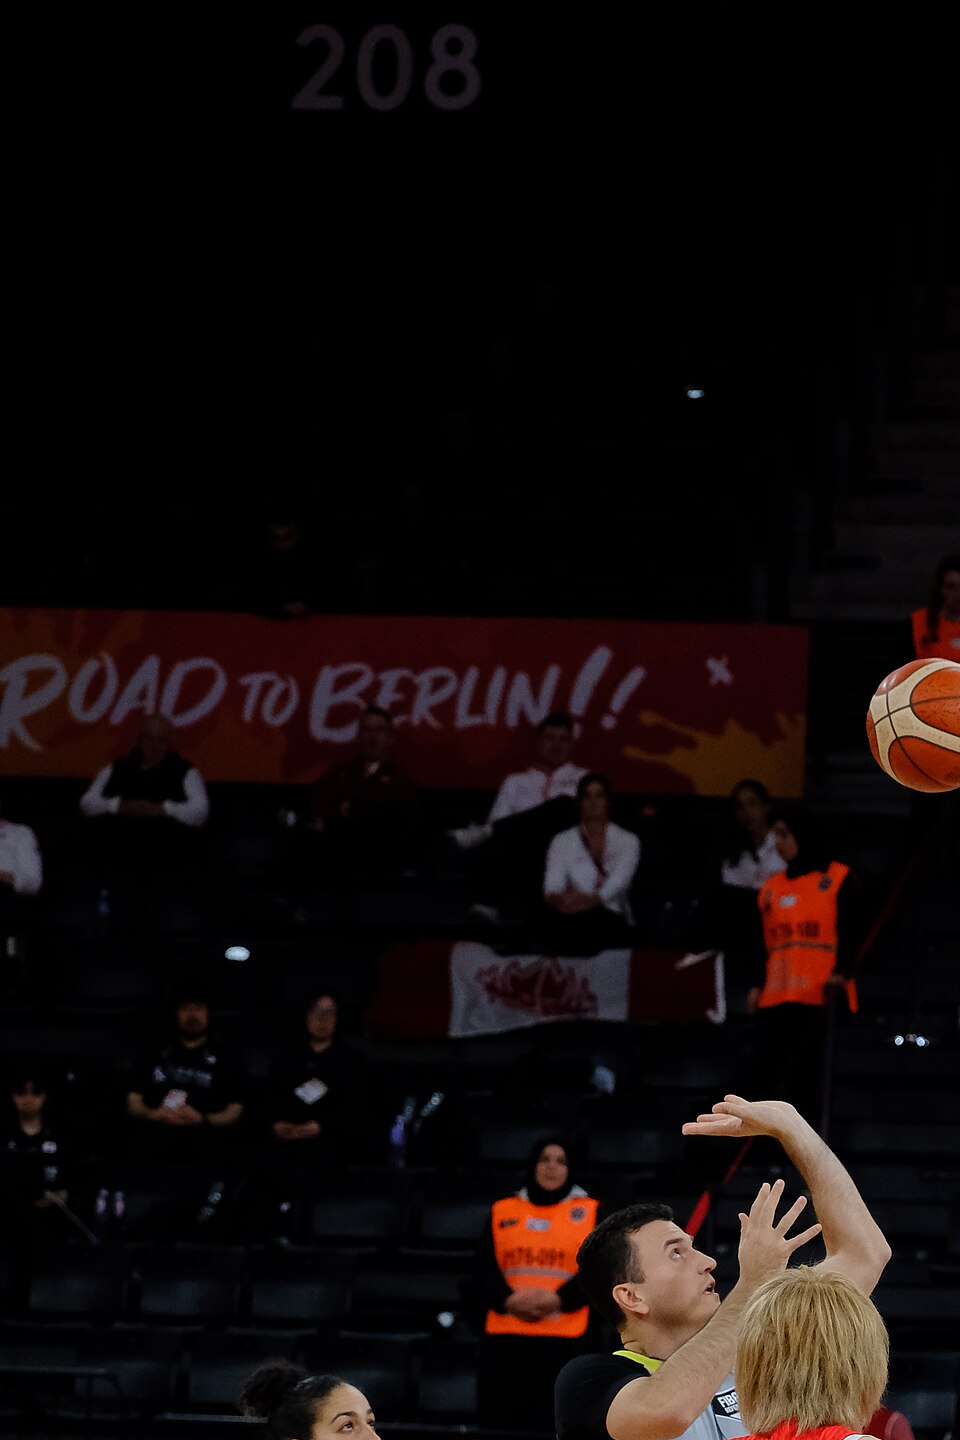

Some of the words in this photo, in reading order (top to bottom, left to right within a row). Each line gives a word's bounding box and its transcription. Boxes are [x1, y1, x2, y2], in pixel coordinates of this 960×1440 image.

[290, 22, 483, 111] 208
[0, 651, 228, 751] ROAD
[238, 672, 300, 726] TO
